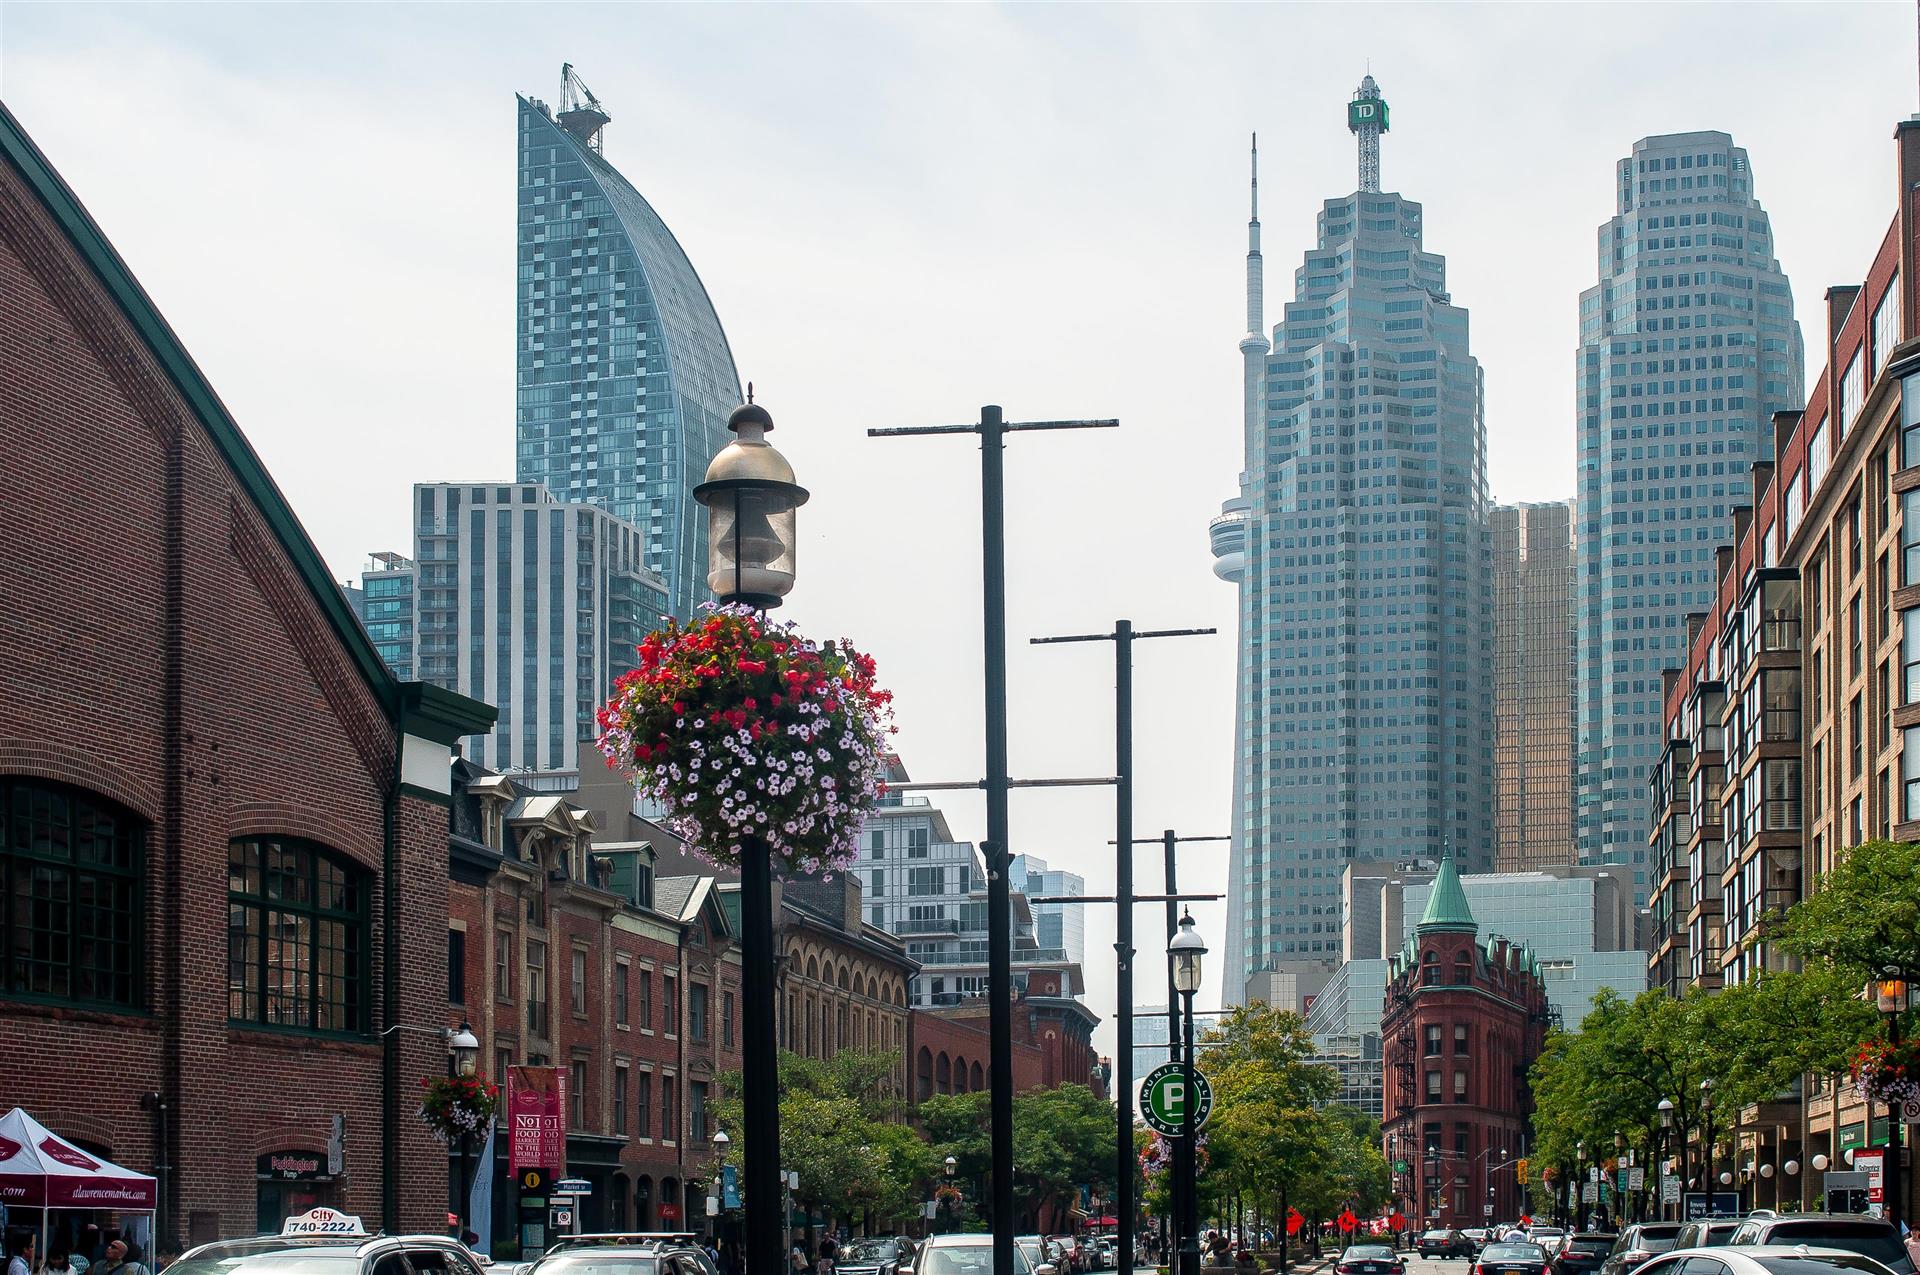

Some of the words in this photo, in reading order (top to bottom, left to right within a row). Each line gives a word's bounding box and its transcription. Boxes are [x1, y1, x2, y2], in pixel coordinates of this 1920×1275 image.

[1355, 104, 1375, 118] TD
[1163, 1083, 1184, 1110] P
[1143, 1106, 1208, 1133] PARKNG
[515, 1130, 541, 1138] FOOD
[544, 1131, 559, 1139] OD
[283, 1170, 298, 1180] Pump
[72, 1184, 147, 1200] stlawrencemarket.com
[311, 1210, 334, 1221] City
